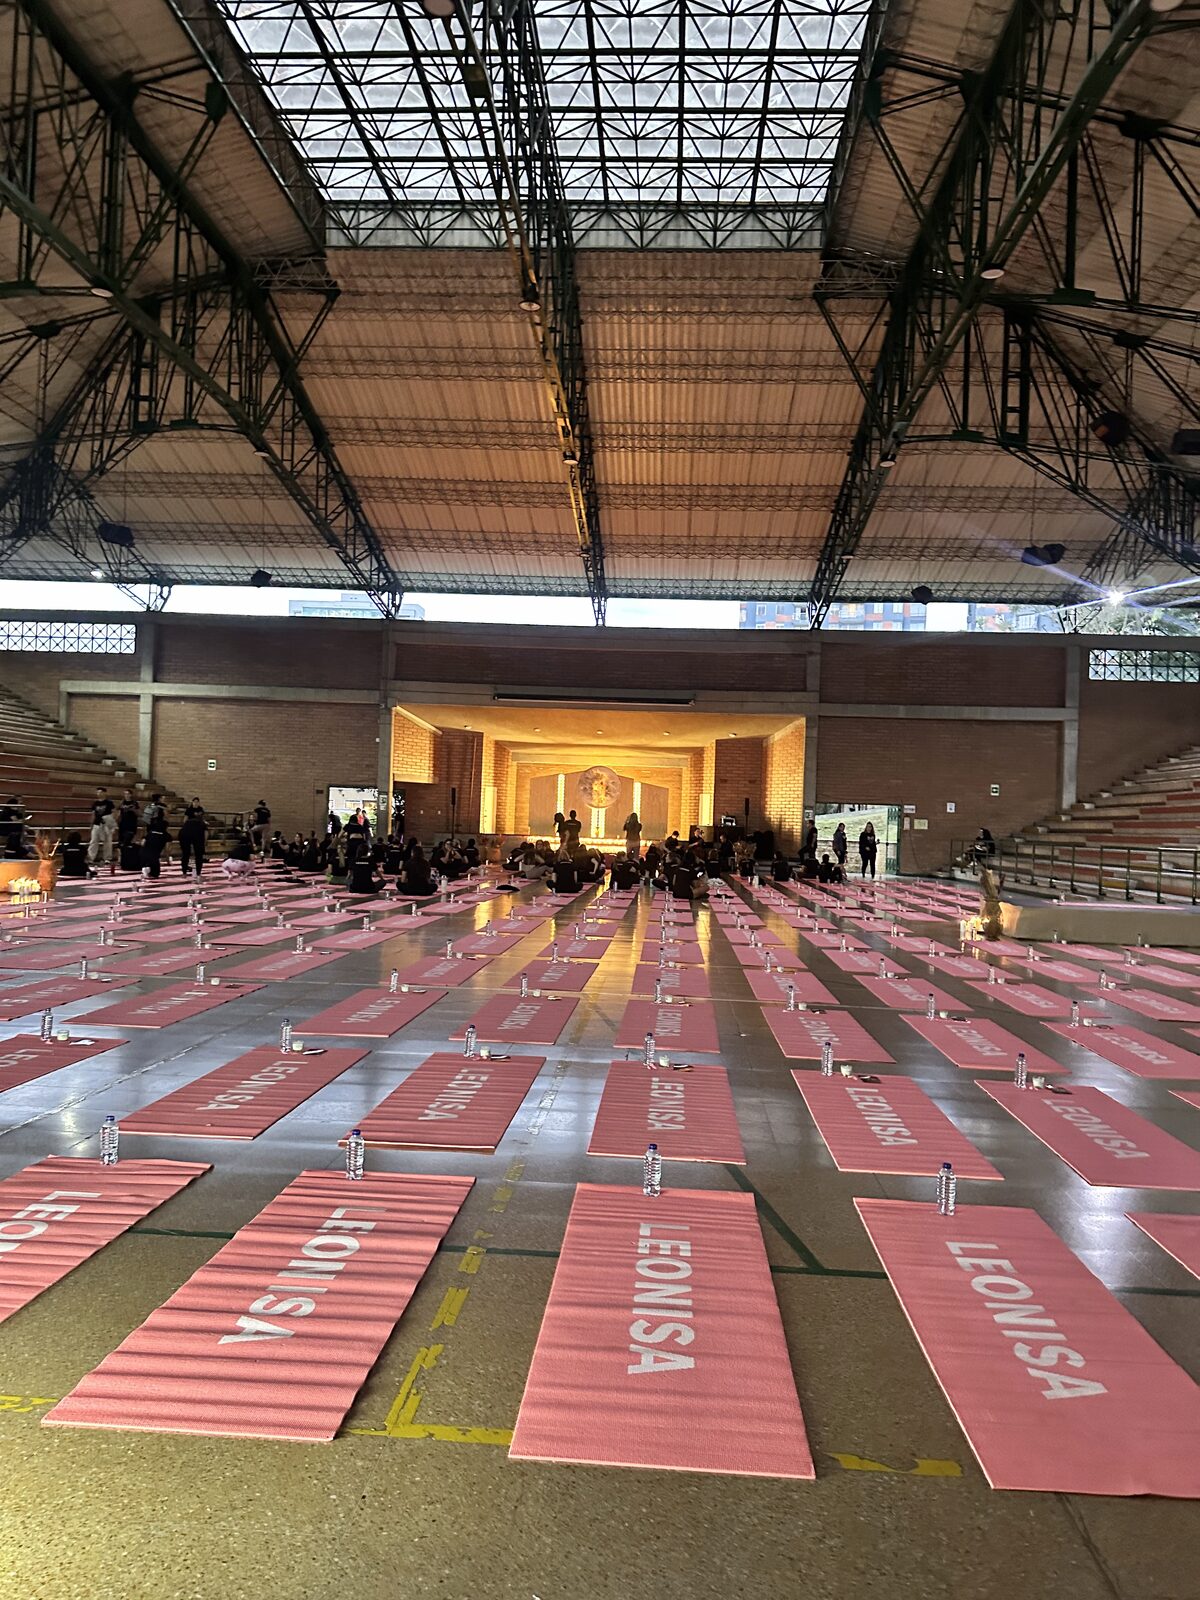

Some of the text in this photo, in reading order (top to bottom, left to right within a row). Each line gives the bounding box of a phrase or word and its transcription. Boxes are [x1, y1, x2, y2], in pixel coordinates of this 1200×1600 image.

[196, 1061, 309, 1111] LEONISA
[417, 1068, 494, 1121] LEONISA
[845, 1086, 919, 1147] LEONISA
[1042, 1098, 1150, 1159] LEONISA
[217, 1207, 387, 1345] LEONISA
[627, 1222, 695, 1375] LEONISA
[945, 1241, 1109, 1400] LEONISA
